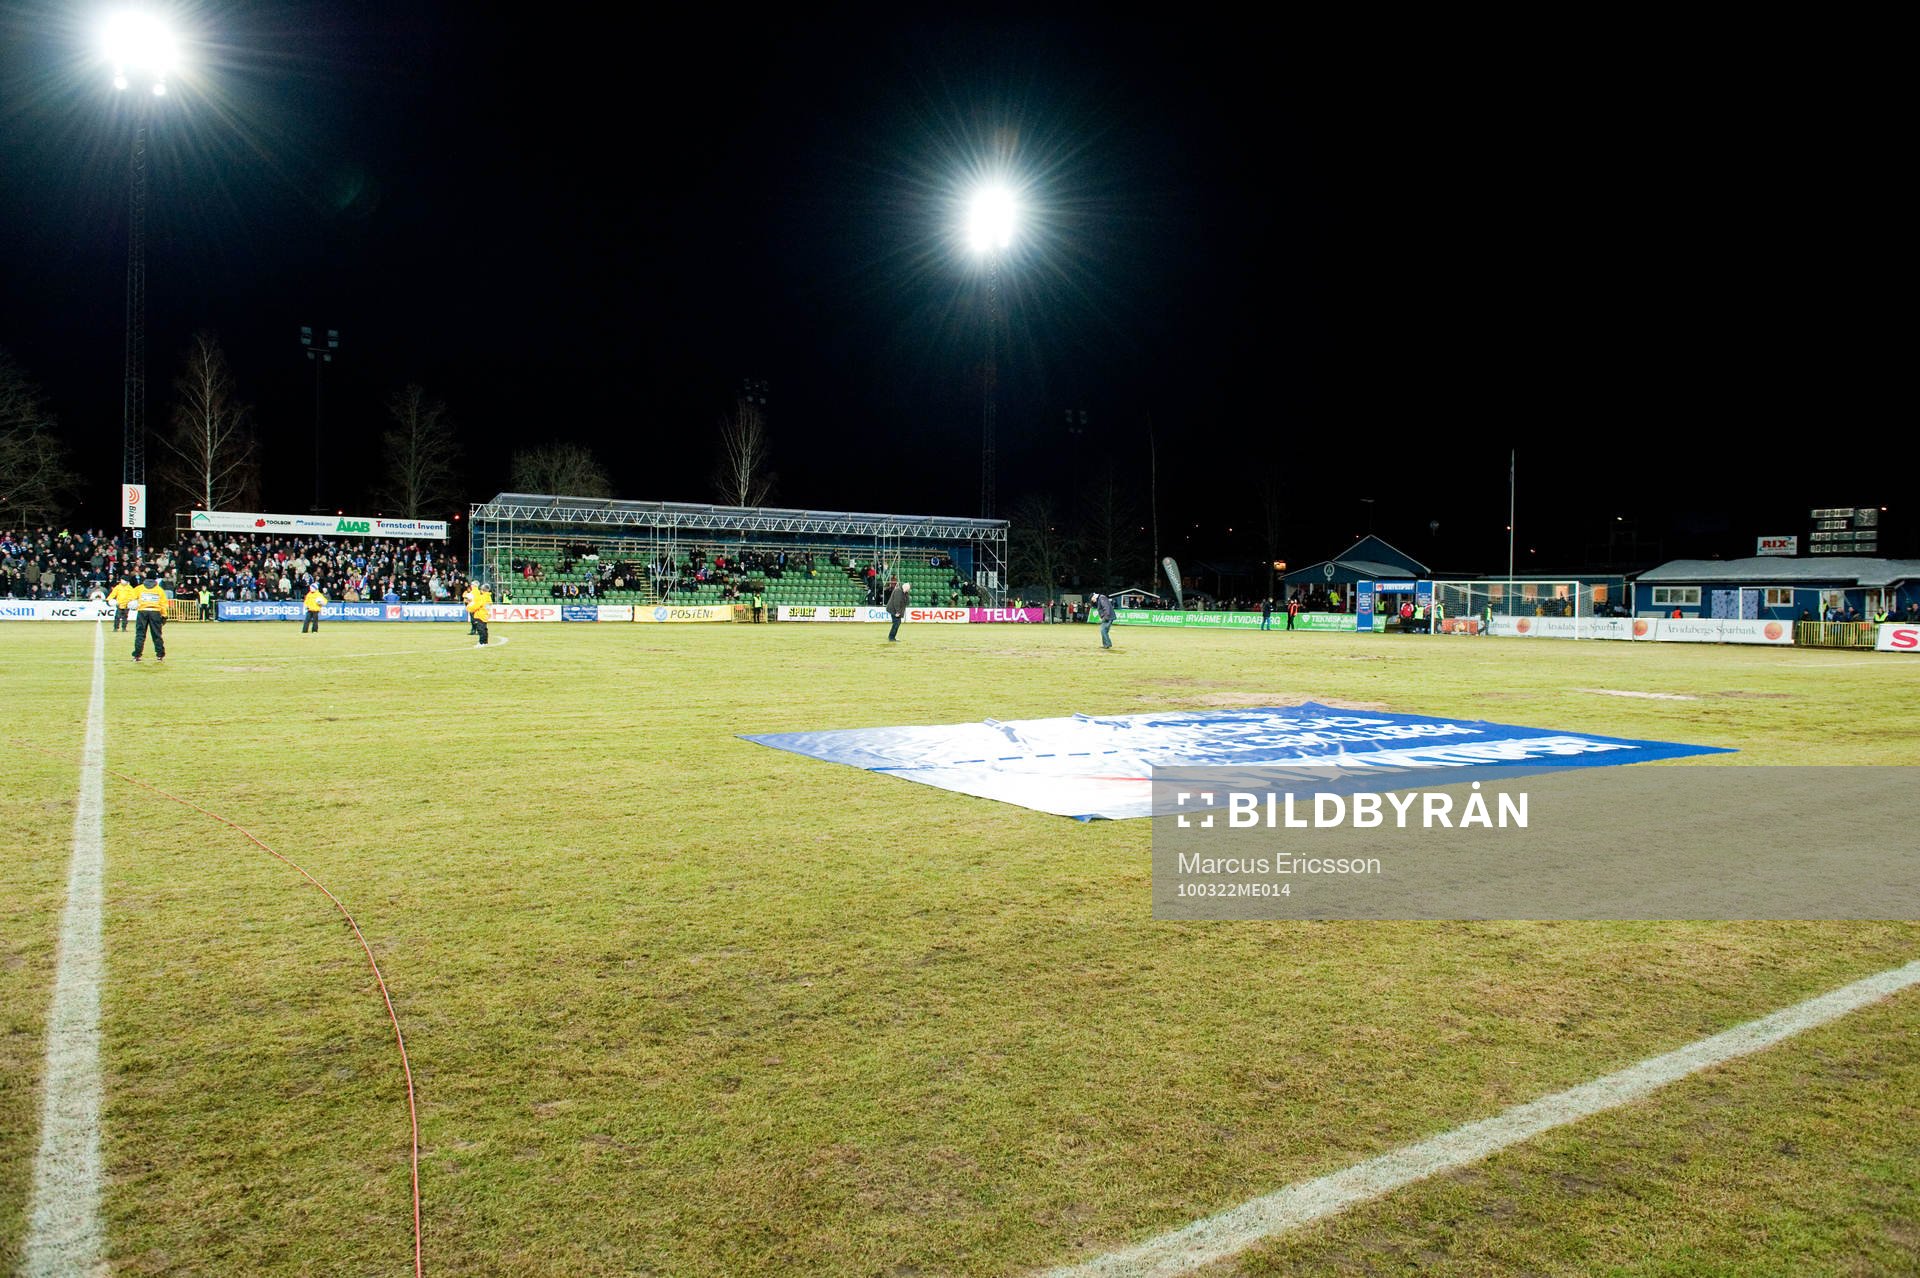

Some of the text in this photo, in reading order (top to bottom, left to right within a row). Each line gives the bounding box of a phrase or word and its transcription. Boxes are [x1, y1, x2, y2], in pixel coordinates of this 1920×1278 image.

[376, 520, 444, 531] Ternstedt Invent
[134, 530, 142, 538] G
[1762, 540, 1787, 548] RIX
[51, 609, 78, 617] NCC
[97, 609, 115, 617] NC
[225, 606, 380, 617] HELA SVERIGES FBOLLSKLUBB
[490, 608, 556, 620] HARP
[670, 609, 714, 619] POSTEN!
[788, 607, 817, 618] SPORT
[828, 607, 857, 618] SPORT
[910, 610, 966, 621] SHARP
[983, 608, 1031, 622] TELIA
[1228, 612, 1281, 625] ÅTVIDABRG
[1891, 630, 1919, 649] S
